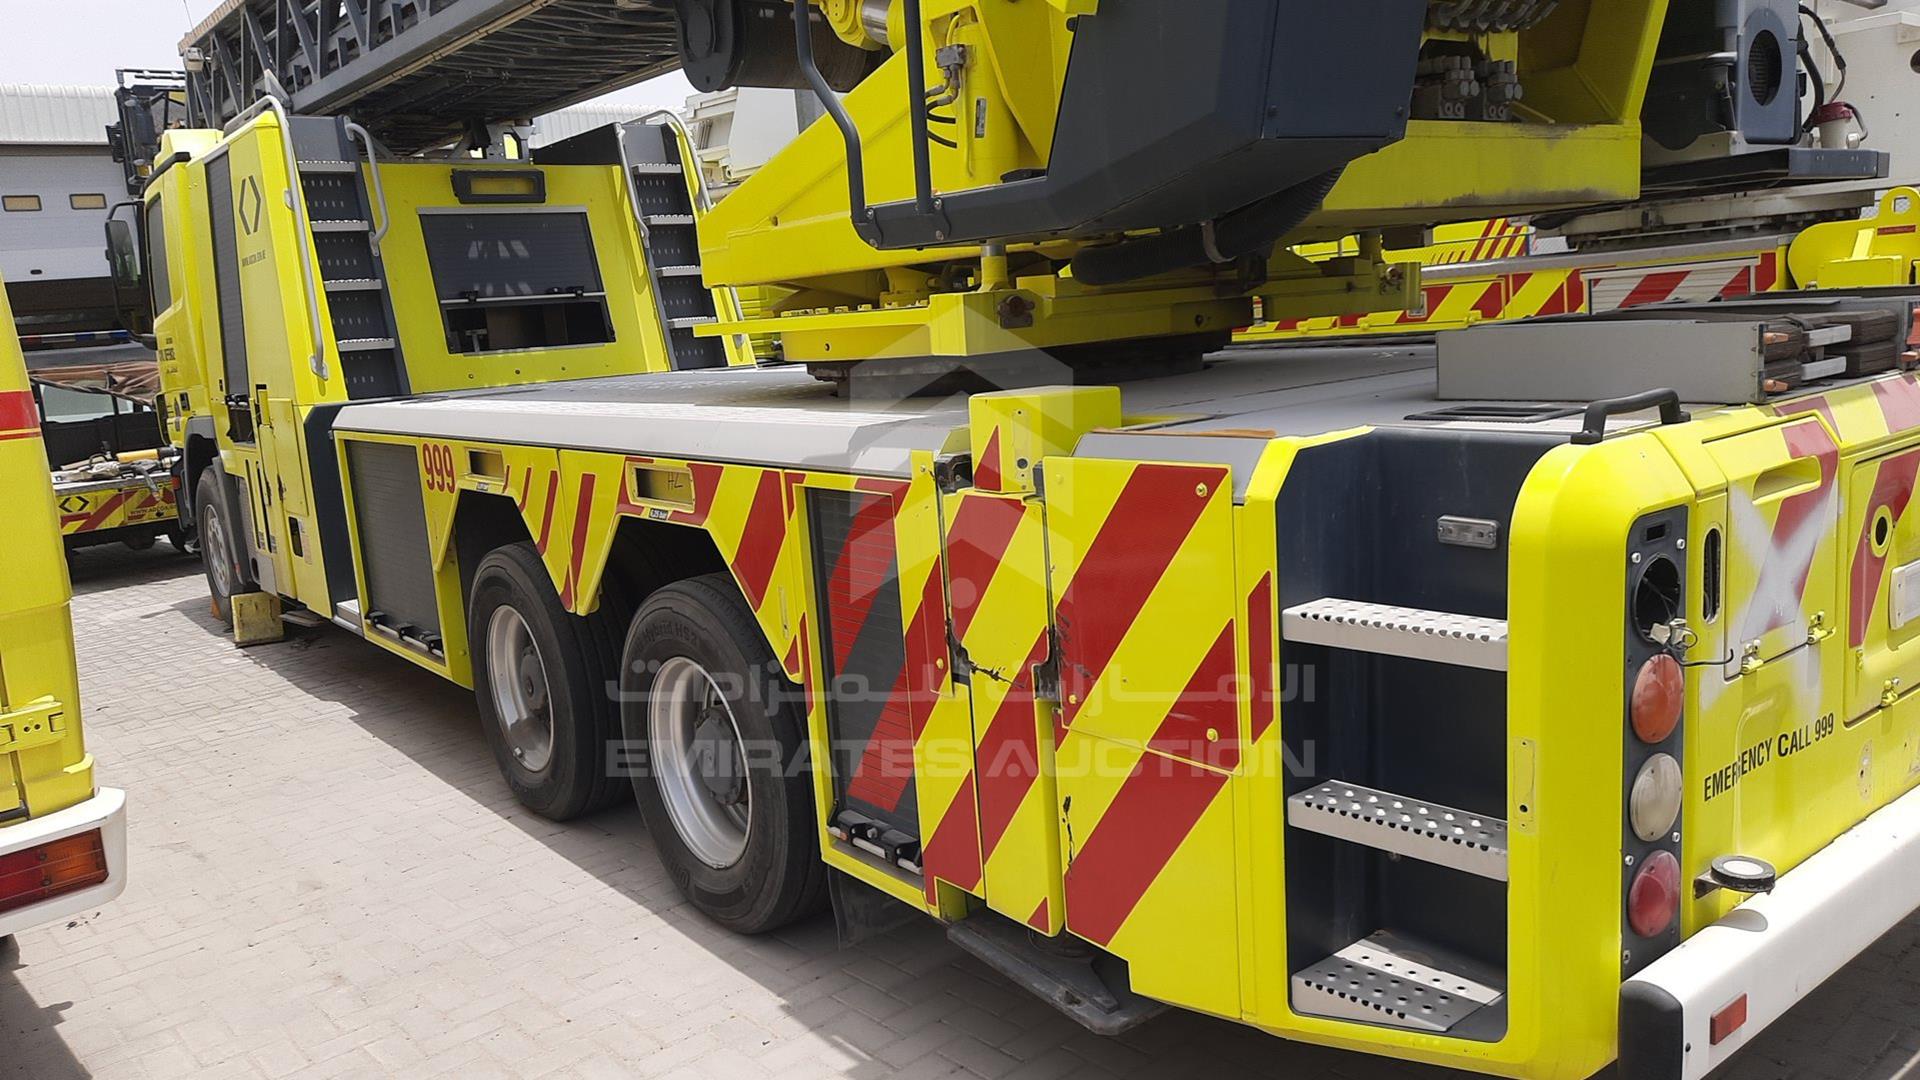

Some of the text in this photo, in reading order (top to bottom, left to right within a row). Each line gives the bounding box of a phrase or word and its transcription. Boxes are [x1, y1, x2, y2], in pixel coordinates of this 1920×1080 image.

[423, 443, 455, 494] 999
[1777, 725, 1811, 757] CALL
[1815, 712, 1834, 742] 999
